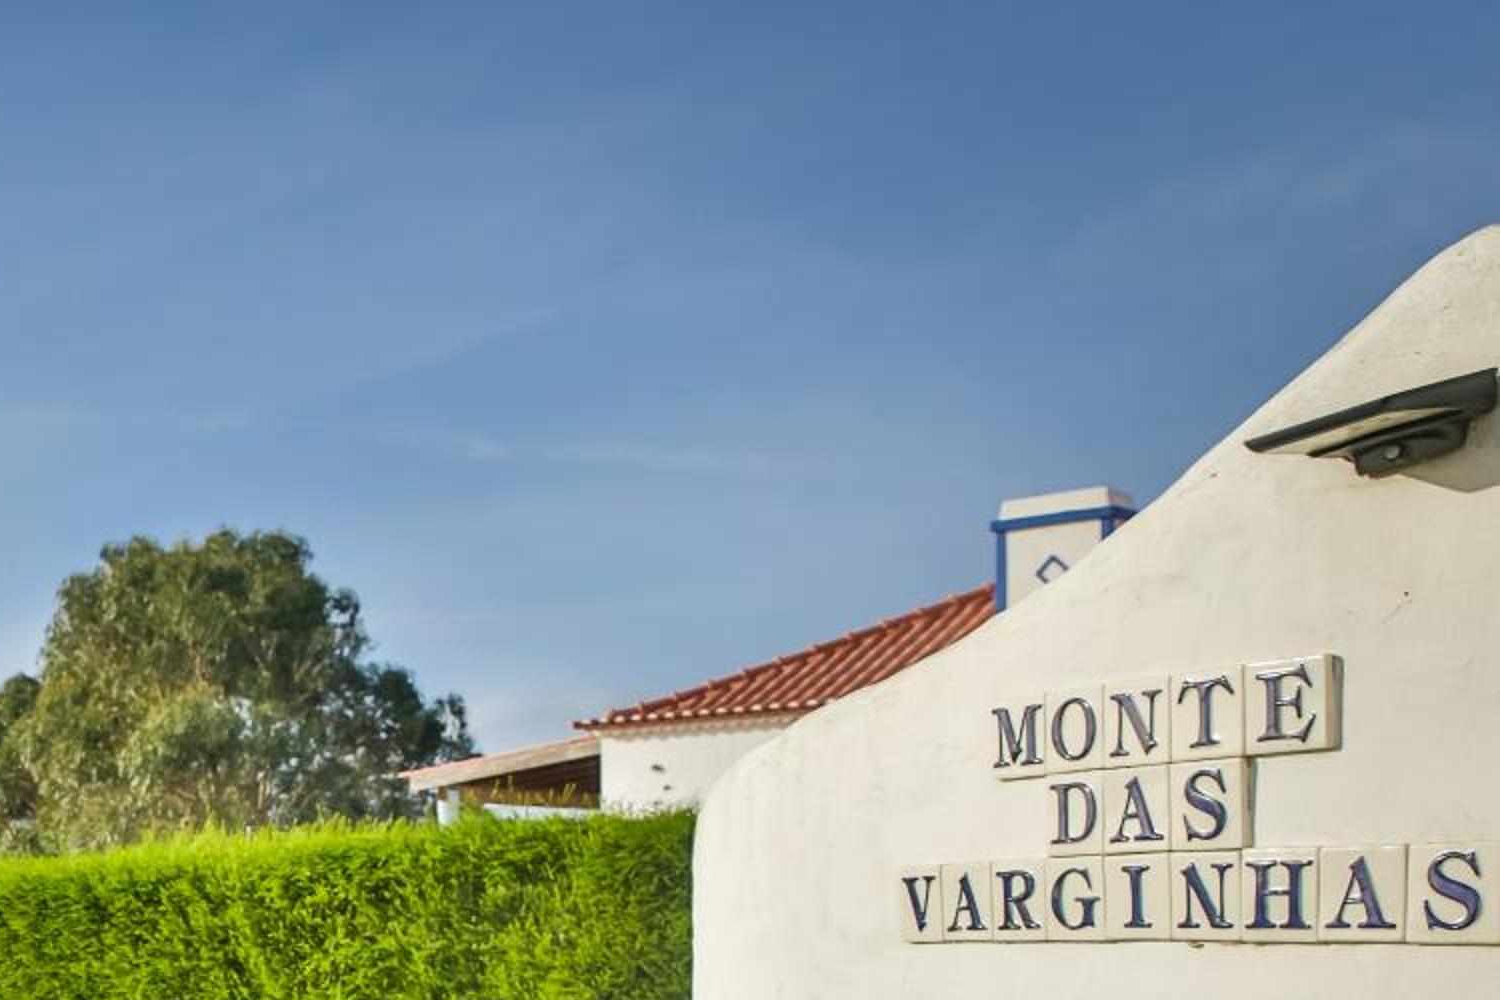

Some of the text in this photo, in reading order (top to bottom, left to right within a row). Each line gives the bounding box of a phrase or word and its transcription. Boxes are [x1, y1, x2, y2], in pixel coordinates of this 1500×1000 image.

[992, 663, 1317, 769] MONTE
[1050, 767, 1228, 845] DAS
[902, 850, 1482, 932] VARGINHAS
